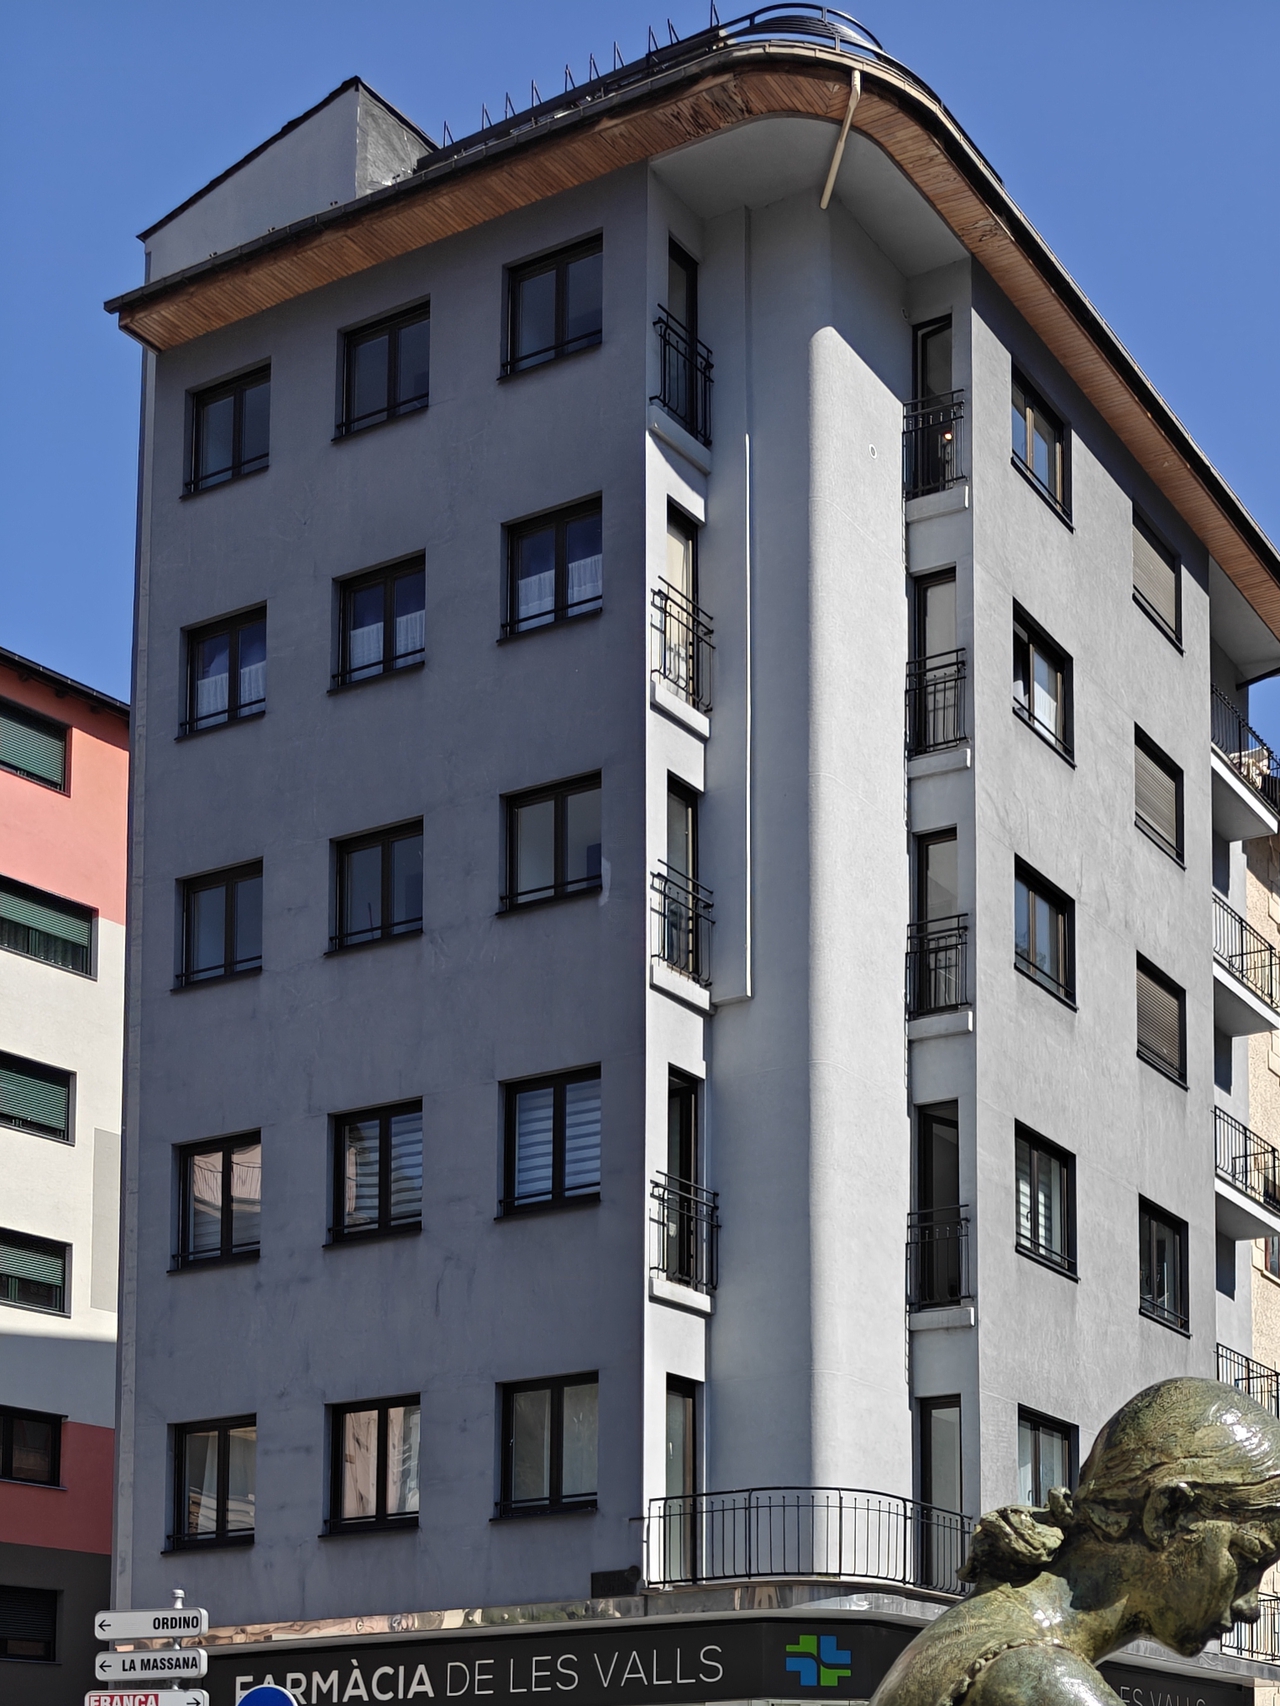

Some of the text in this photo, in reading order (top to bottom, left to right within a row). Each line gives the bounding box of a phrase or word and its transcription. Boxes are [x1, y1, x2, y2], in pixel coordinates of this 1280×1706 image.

[152, 1615, 199, 1630] ORDINO
[121, 1656, 198, 1672] LA MASSANA
[235, 1645, 724, 1706] FRMÀCIA DE LES VALLS
